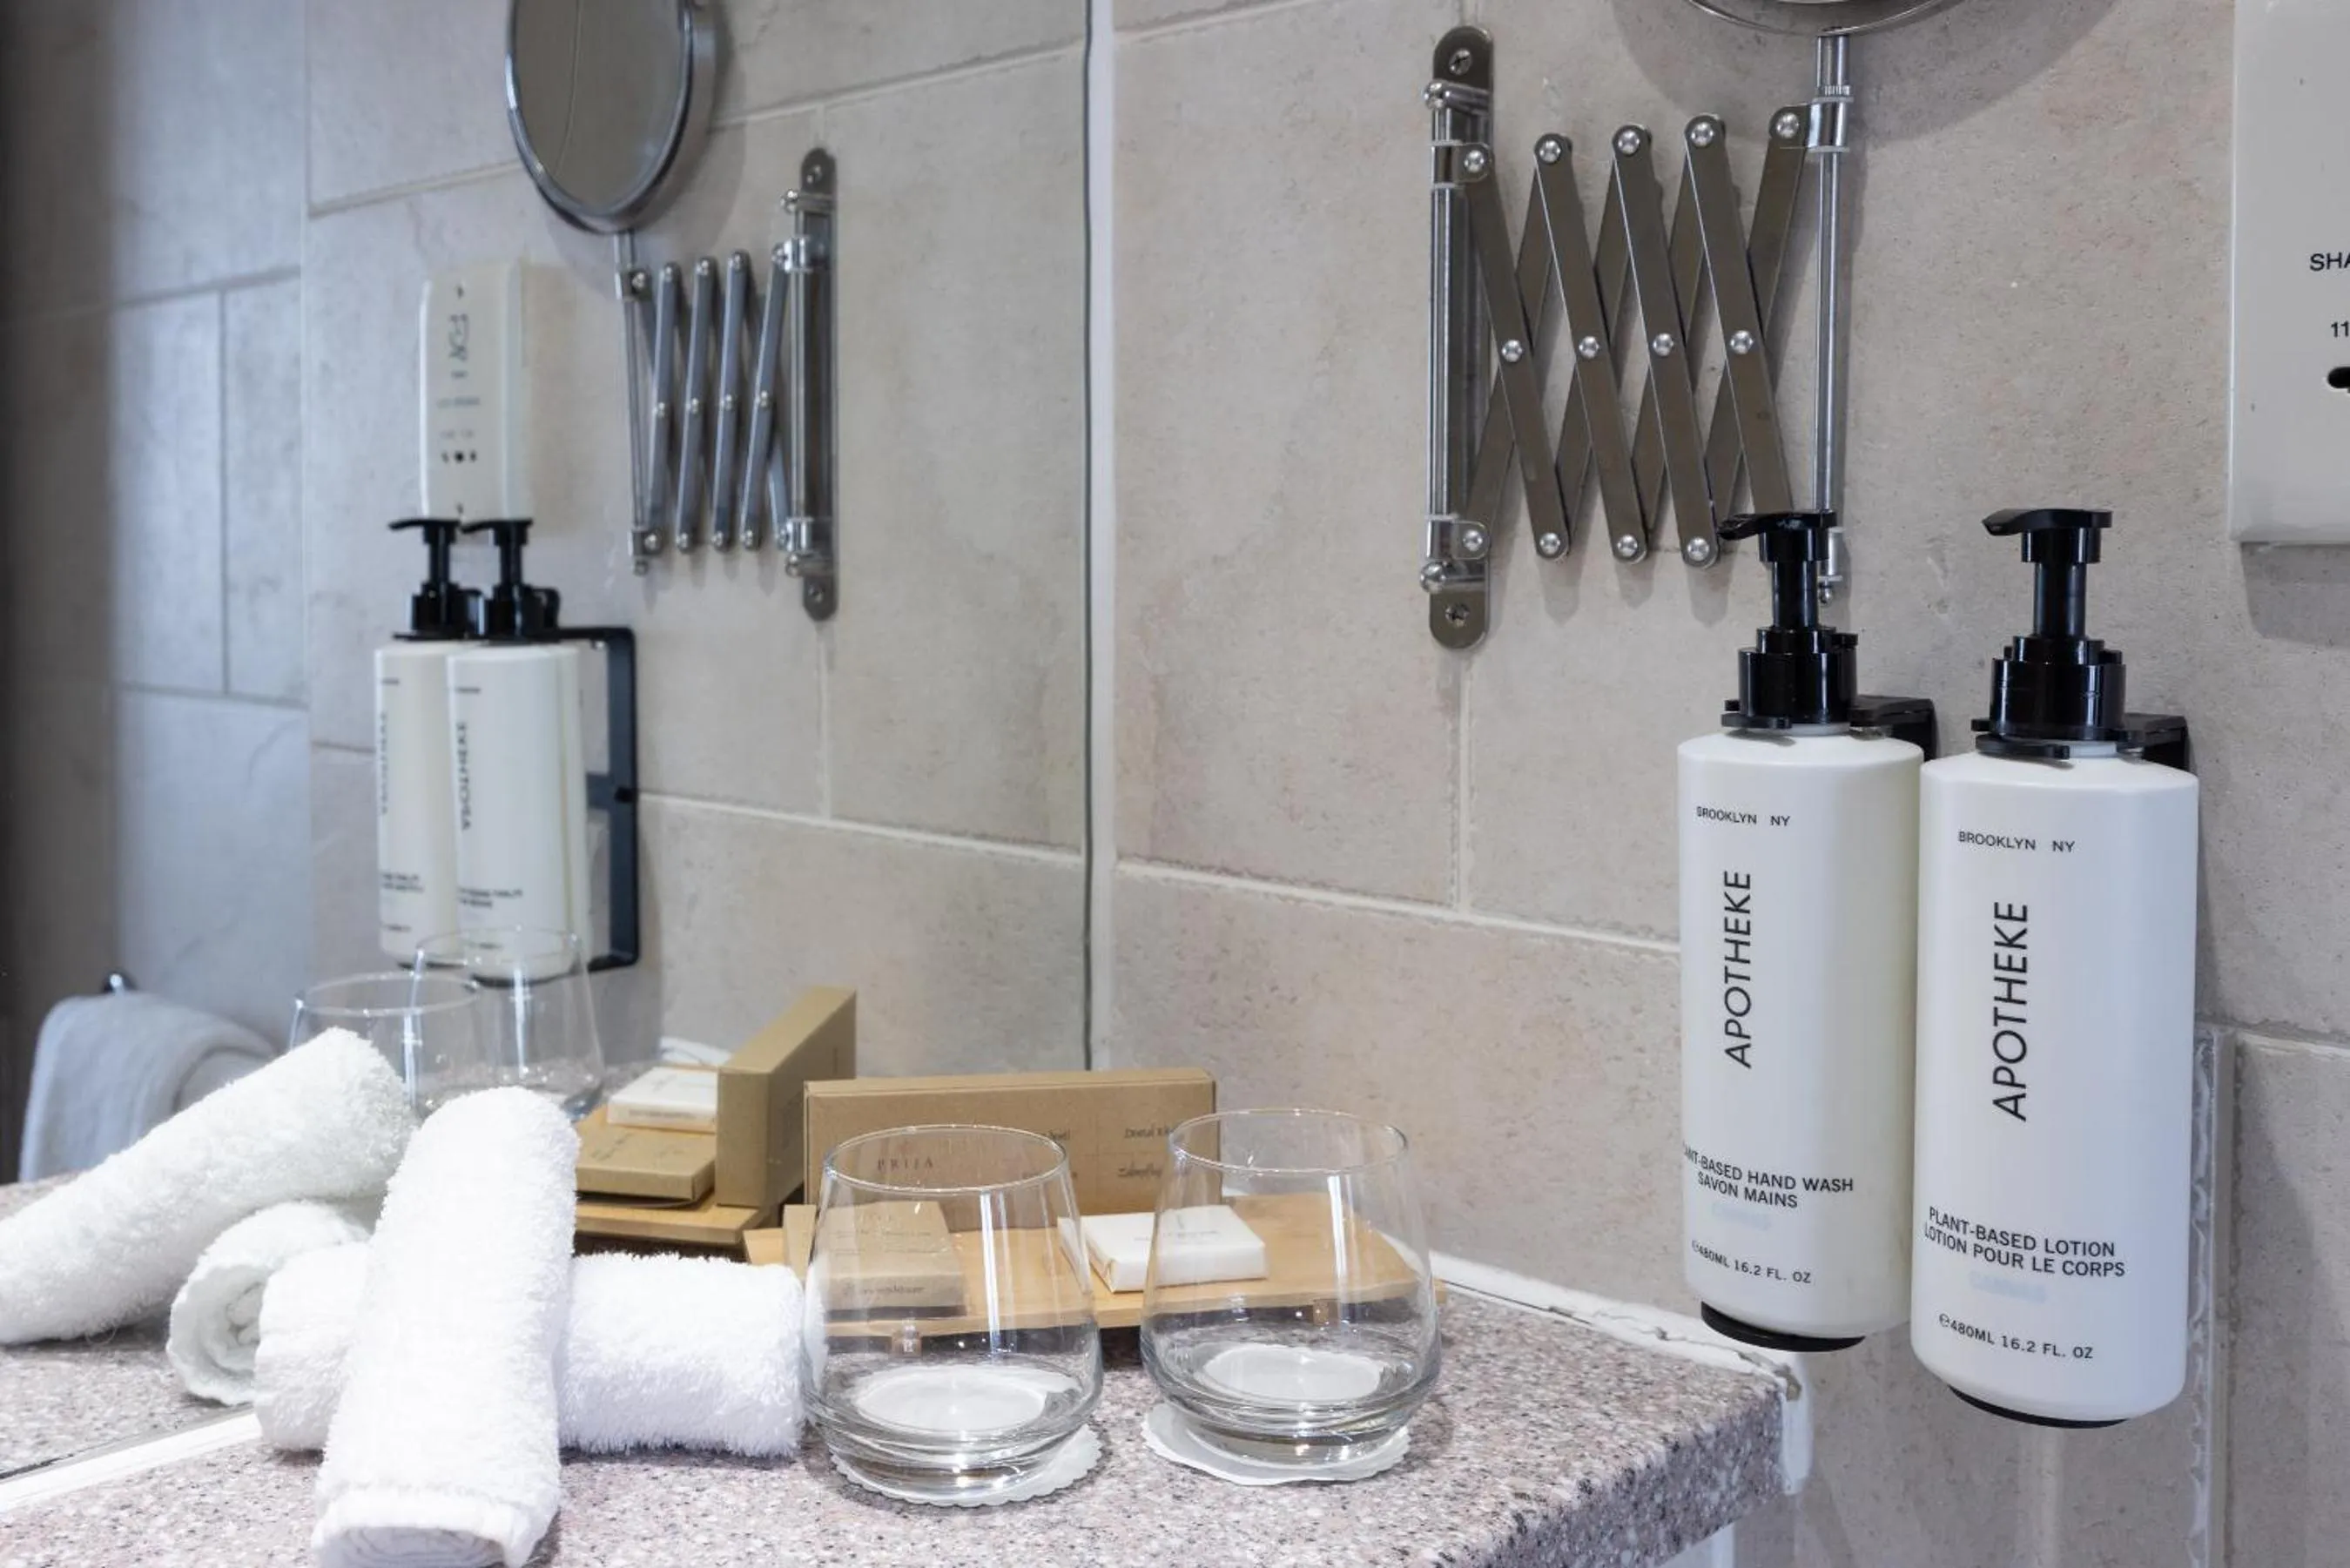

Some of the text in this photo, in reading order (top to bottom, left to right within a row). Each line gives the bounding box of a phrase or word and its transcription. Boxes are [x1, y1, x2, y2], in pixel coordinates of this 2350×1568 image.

[1696, 806, 1790, 826] BROOKLYN NY
[1958, 831, 2075, 852] BROOKLYN NY
[1724, 871, 1751, 1068] APOTHEKE
[1992, 901, 2028, 1121] APOTHEKE
[1698, 1172, 1798, 1208] SAVON MAINS
[1748, 1170, 1796, 1190] HAND
[1803, 1177, 1854, 1193] WASH
[1929, 1206, 2115, 1257] PLANT-BASED LOTION
[1924, 1221, 2124, 1277] LOTION POUR LE CORPS
[1734, 1259, 1761, 1276] 16.2
[1767, 1267, 1787, 1281] FL.
[1793, 1270, 1811, 1283] OZ
[2002, 1335, 2036, 1353] 16.2
[2043, 1343, 2066, 1358] FL.
[2072, 1346, 2093, 1359] OZ
